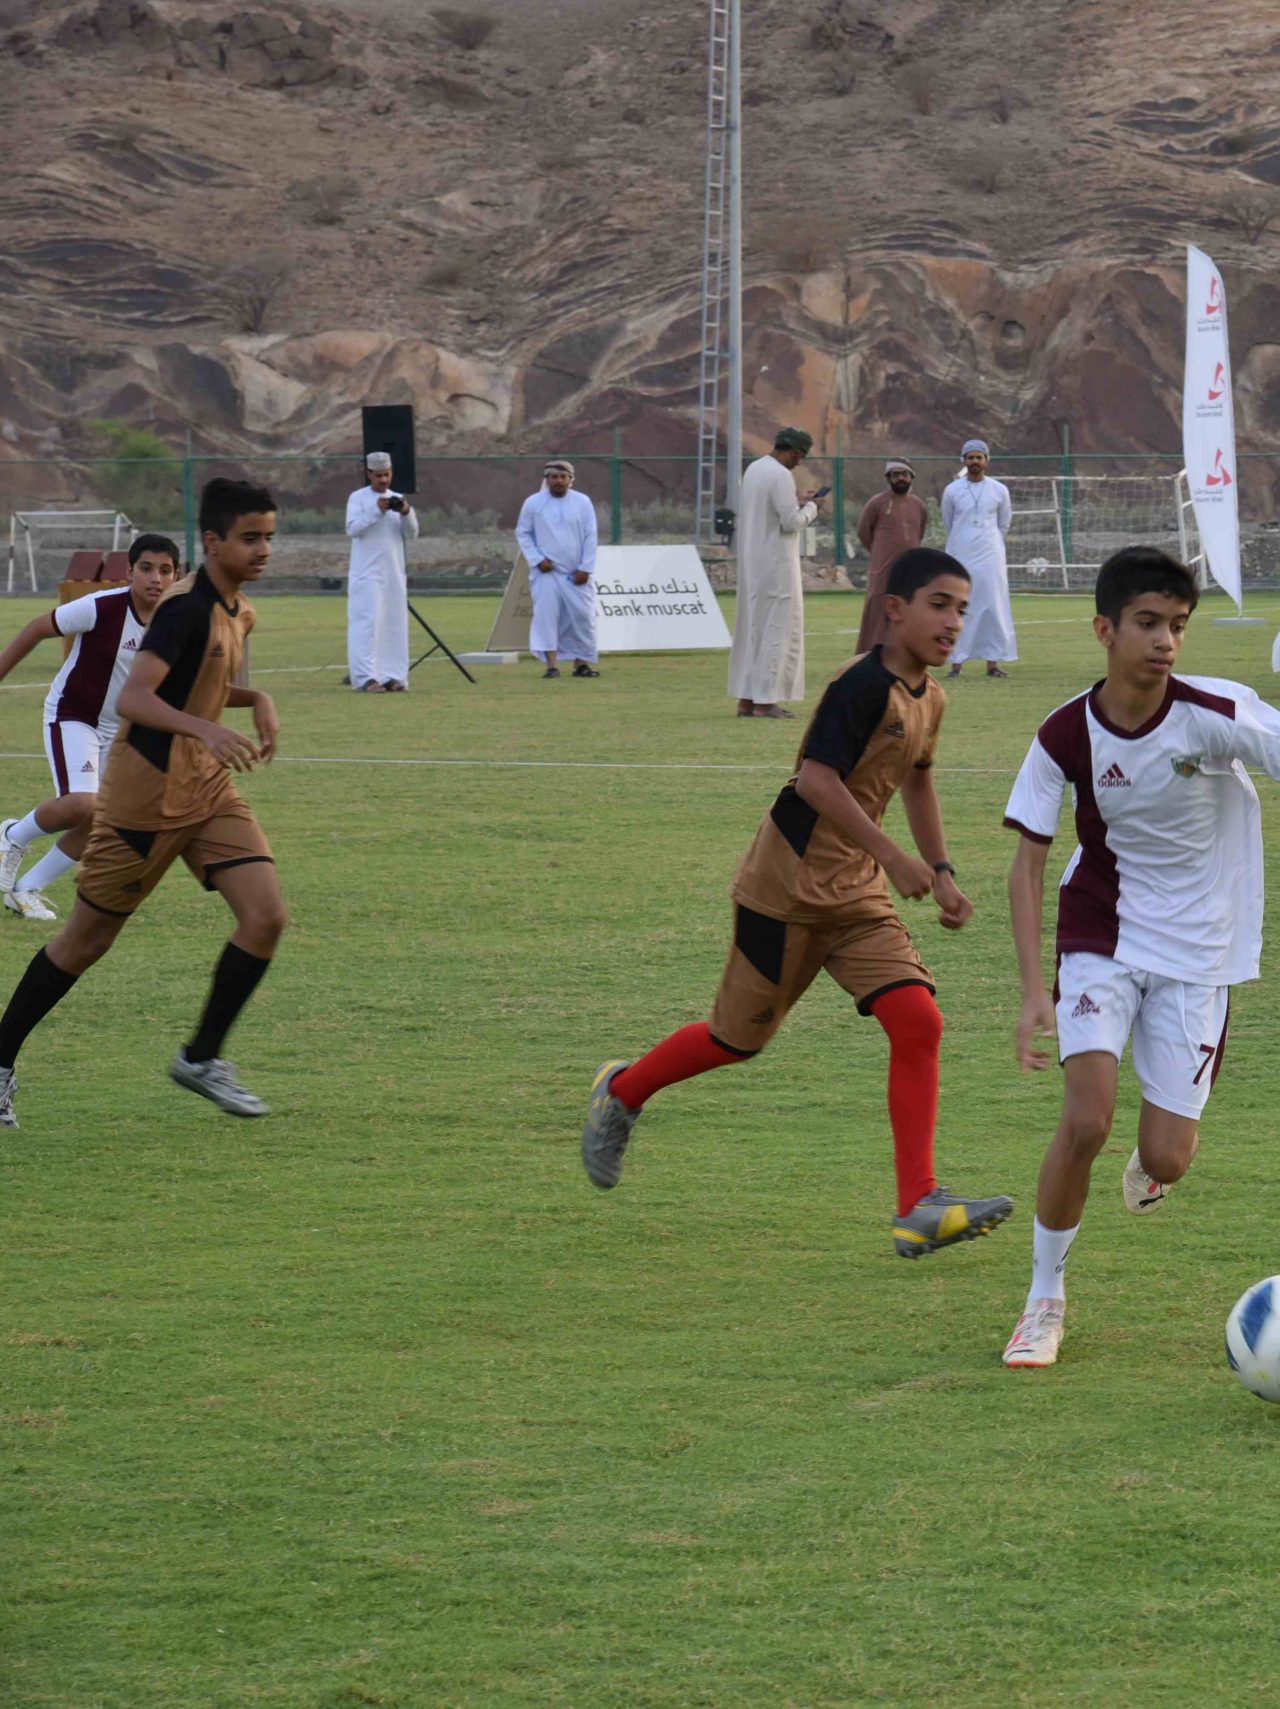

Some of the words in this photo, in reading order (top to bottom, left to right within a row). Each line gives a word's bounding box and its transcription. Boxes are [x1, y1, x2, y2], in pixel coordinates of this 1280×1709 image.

[594, 579, 659, 595] مسقط
[661, 578, 699, 597] بنك
[600, 600, 643, 617] bank
[647, 600, 707, 616] muscat
[1097, 777, 1132, 788] adidas
[1193, 1043, 1216, 1086] 7
